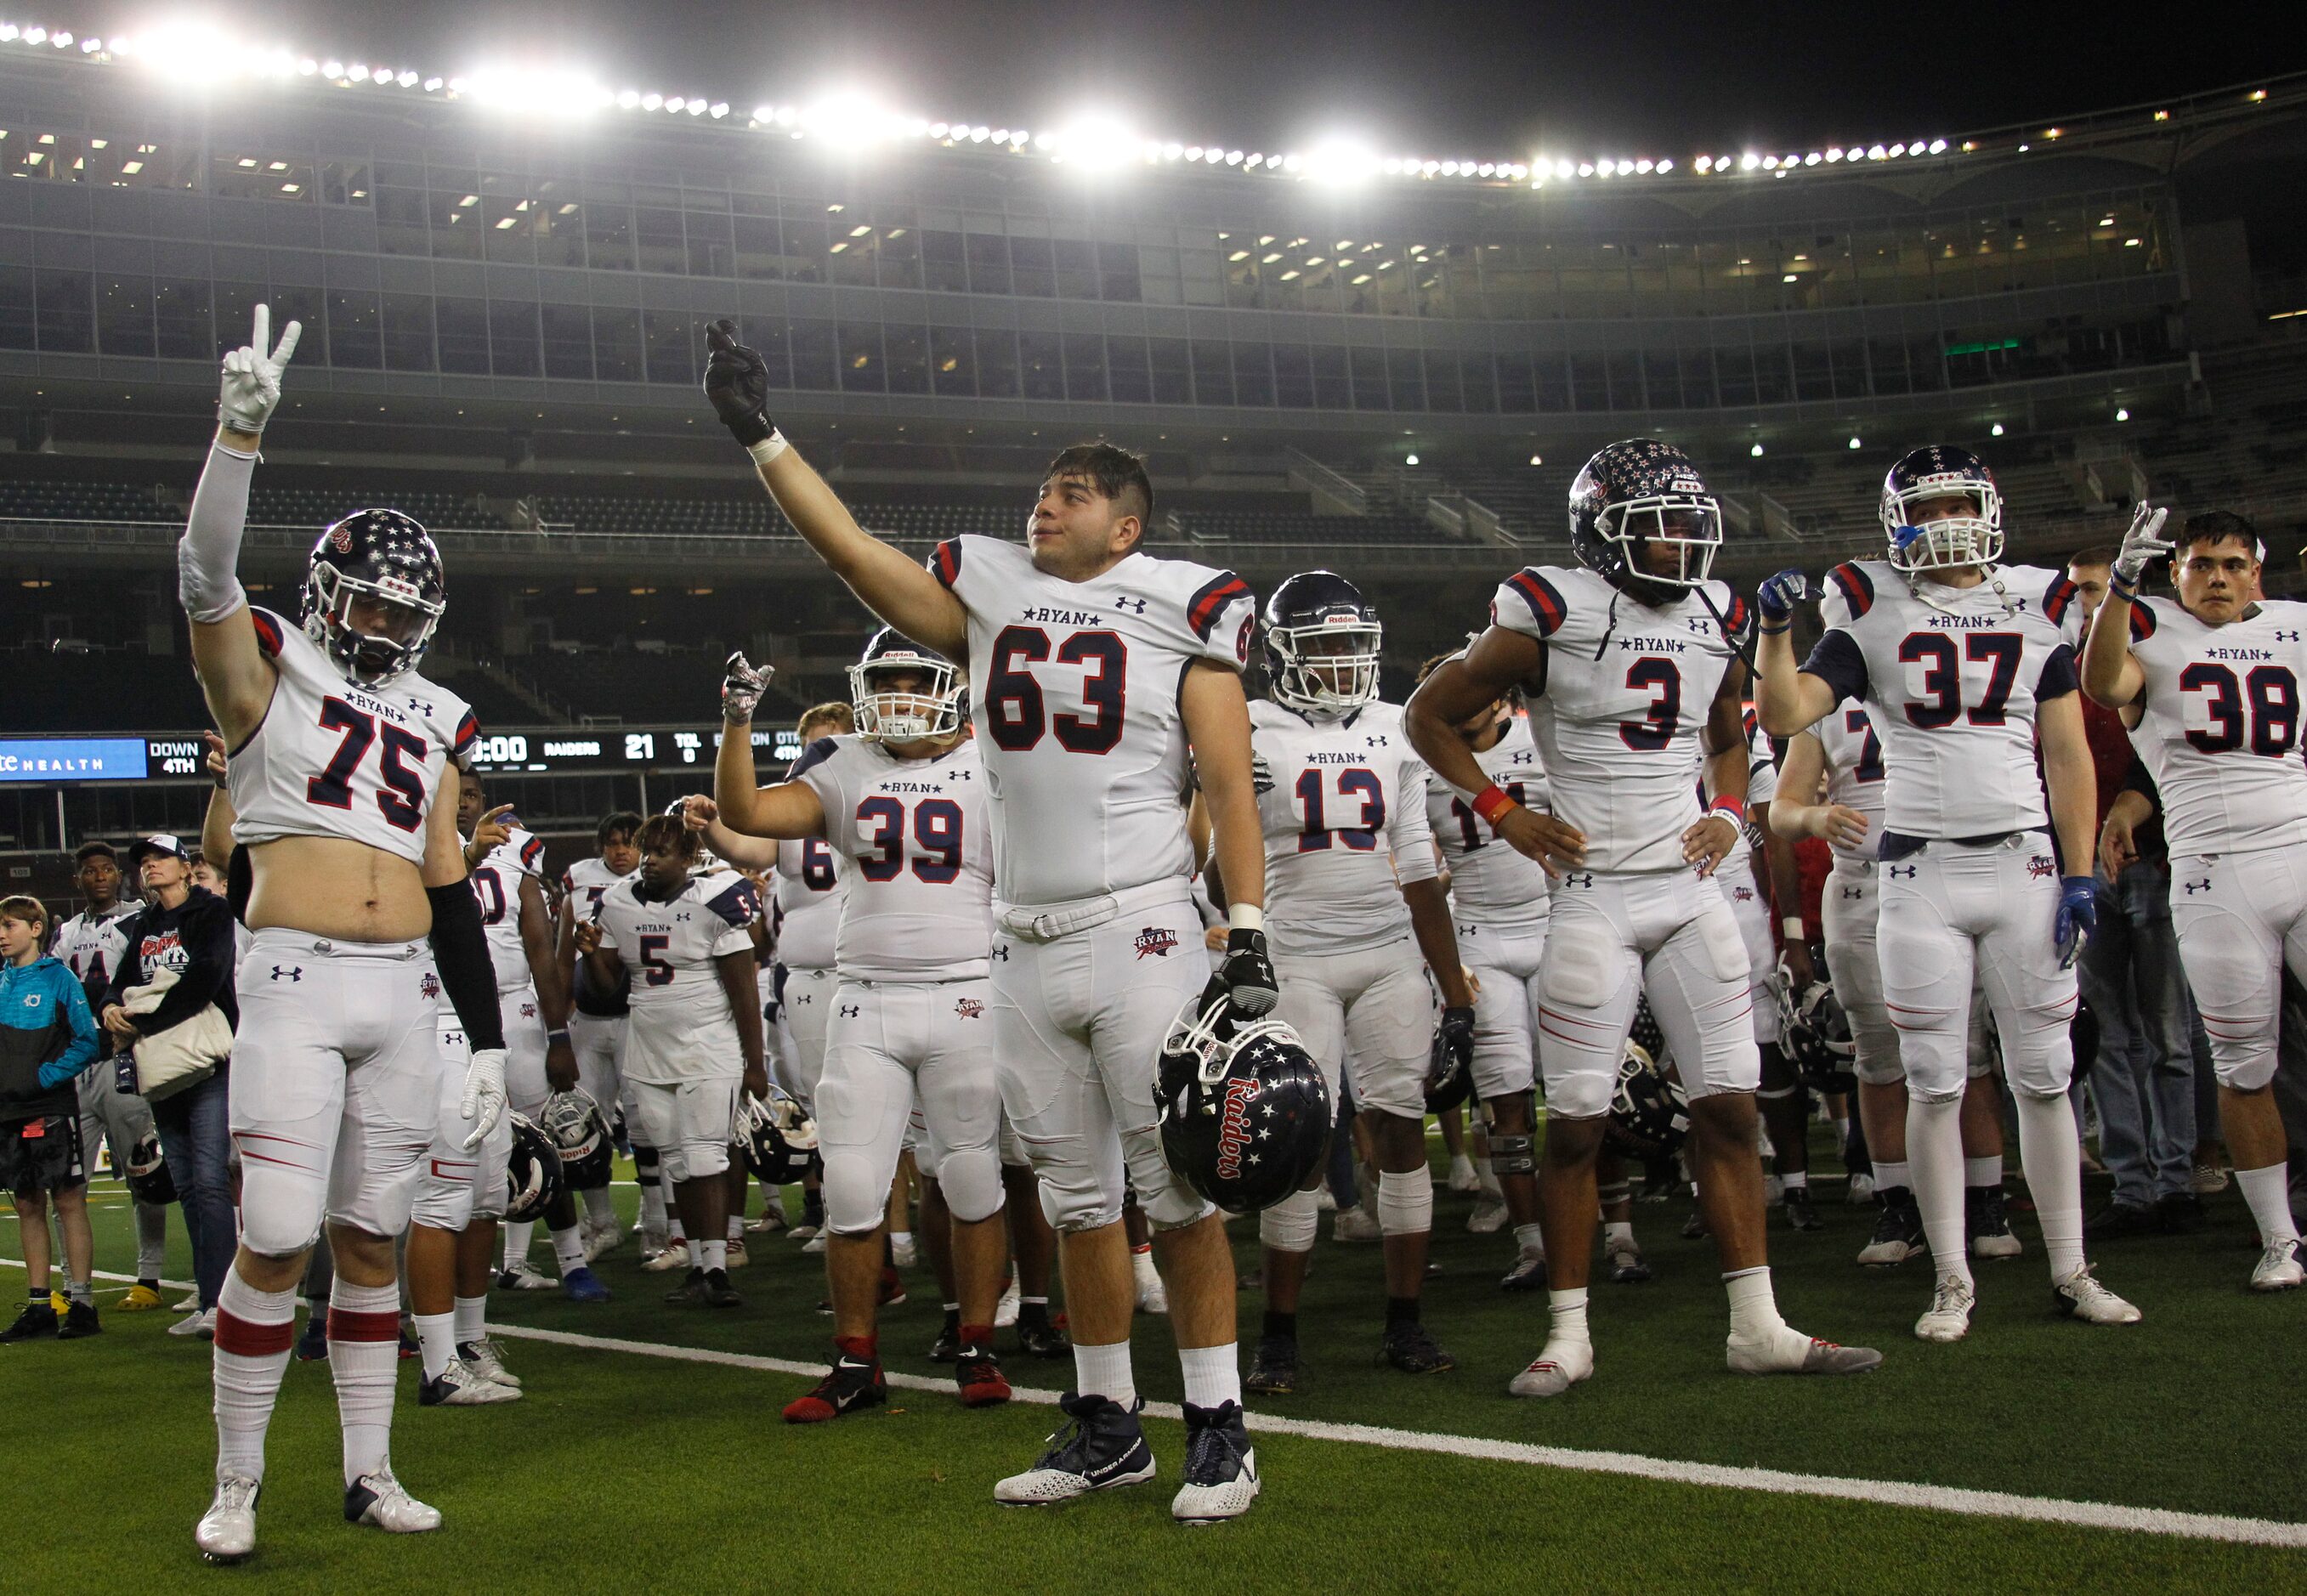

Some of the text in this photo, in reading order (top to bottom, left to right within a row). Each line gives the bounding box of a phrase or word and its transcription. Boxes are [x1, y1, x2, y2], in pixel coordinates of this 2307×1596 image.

[1036, 608, 1088, 625] RYAN
[1941, 616, 1982, 628] RYAN
[1633, 637, 1676, 653] RYAN
[2218, 648, 2260, 660] RYAN
[984, 625, 1128, 756] 63
[1898, 632, 2024, 730] 37
[356, 693, 395, 720] RYAN
[1618, 657, 1681, 751] 3
[2179, 662, 2300, 758] 38
[150, 742, 199, 757] DOWN
[544, 742, 600, 756] RAIDERS
[625, 733, 654, 760] 21
[23, 758, 104, 772] HEALTH
[162, 758, 196, 773] 4TH
[307, 695, 428, 834] 75
[1318, 753, 1356, 763] RYAN
[891, 783, 932, 793] RYAN
[1295, 768, 1386, 853] 13
[856, 795, 963, 885] 39
[642, 925, 666, 933] RYAN
[1137, 931, 1175, 948] RYAN
[640, 935, 676, 987] 5
[1217, 1077, 1261, 1180] Raiders
[1091, 1436, 1142, 1477] UNDER ARMOUR
